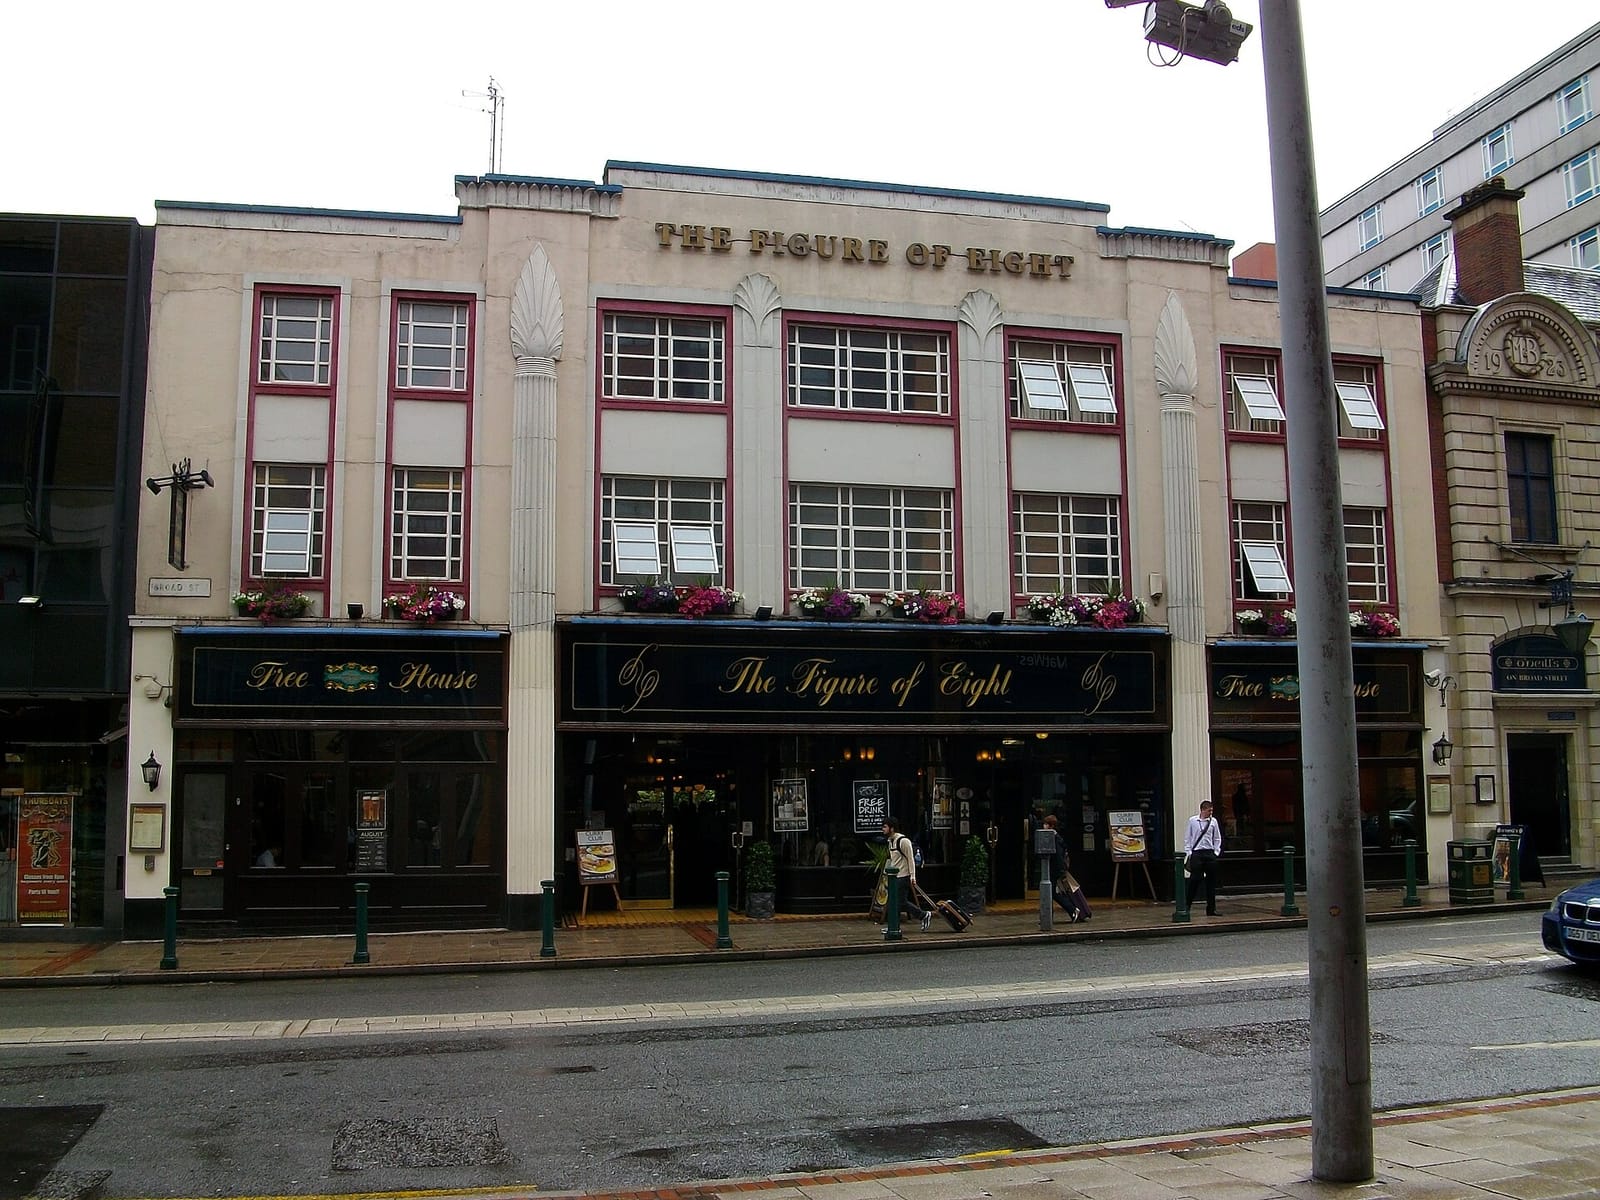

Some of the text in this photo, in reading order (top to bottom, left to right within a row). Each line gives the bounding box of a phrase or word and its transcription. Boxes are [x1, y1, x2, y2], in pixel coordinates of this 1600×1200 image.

[655, 222, 1075, 278] THE FIGURE OF EIGHT
[246, 661, 480, 693] Free House
[718, 656, 1012, 708] The Figure of Eight
[1216, 673, 1383, 701] Free use
[1506, 673, 1568, 682] ON BROAD STREET
[858, 797, 885, 806] FREE
